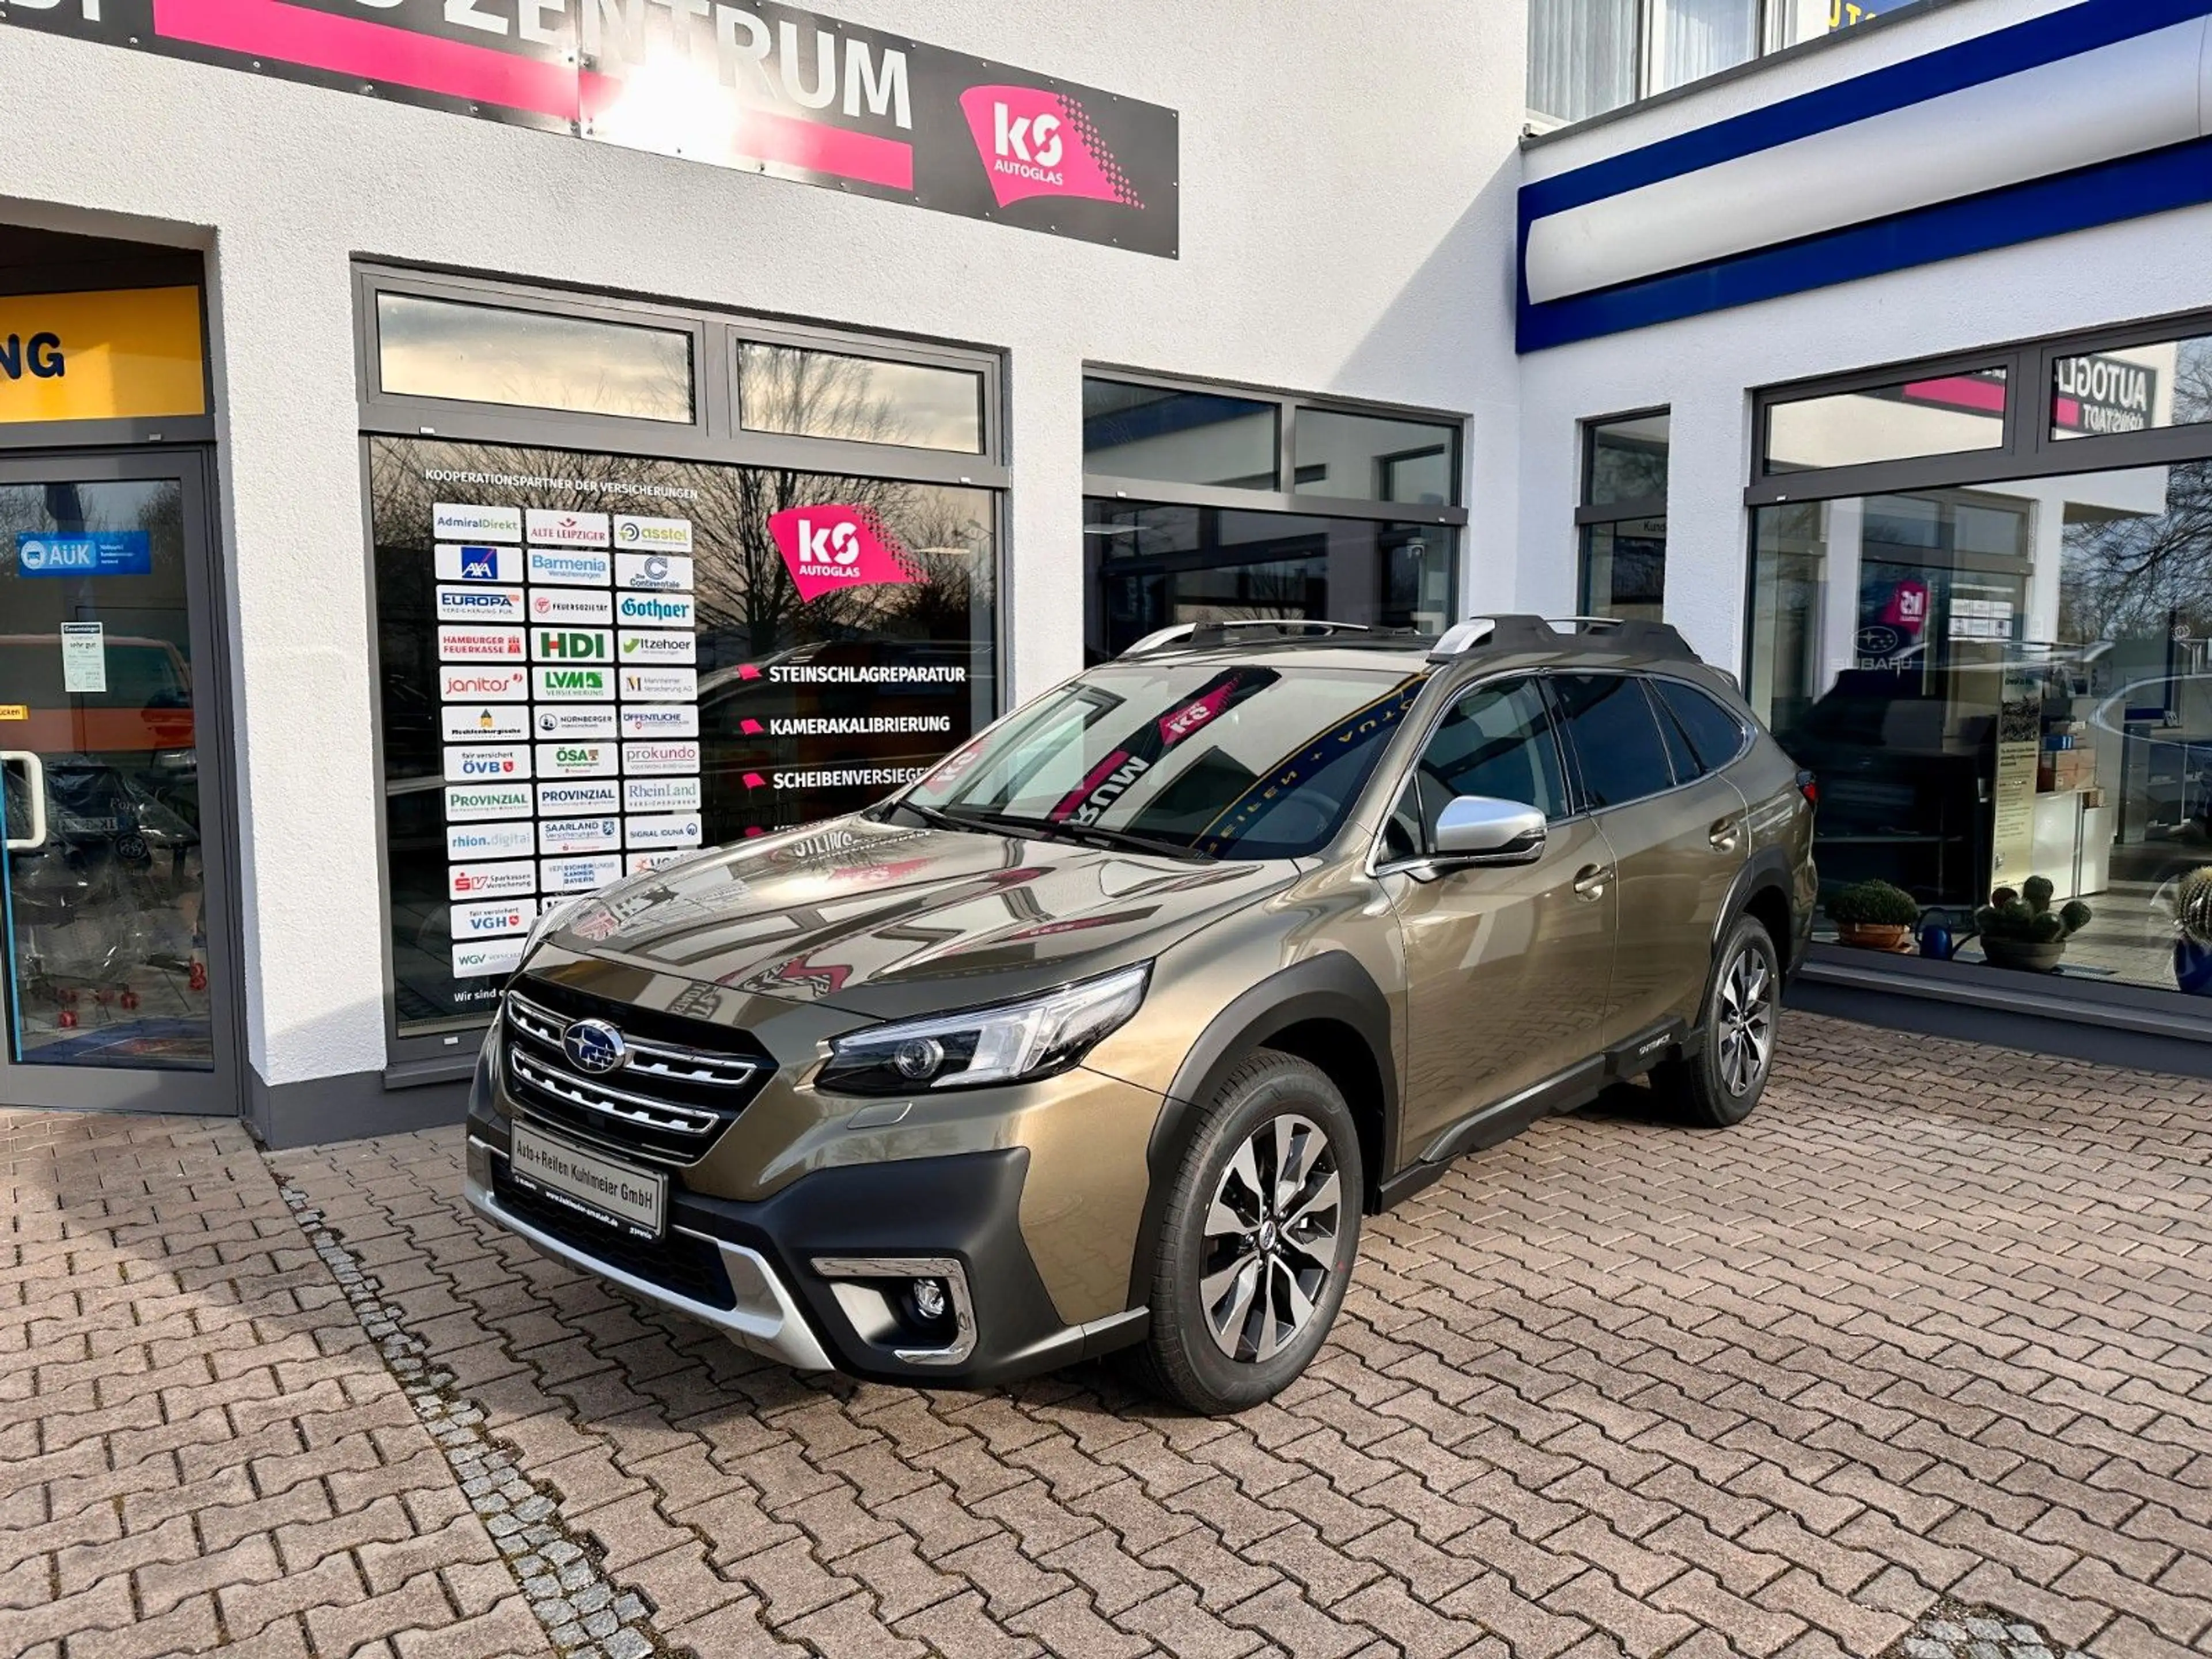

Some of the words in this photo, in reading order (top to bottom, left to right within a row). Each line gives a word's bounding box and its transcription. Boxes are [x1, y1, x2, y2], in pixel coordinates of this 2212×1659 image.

[994, 159, 1063, 185] AUTOGLAS
[425, 469, 571, 490] KOOPERATIONSPARTNER
[575, 479, 597, 493] DER
[600, 482, 698, 499] VERSICHERUNGEN
[437, 517, 518, 531] AdmiralDirekt
[531, 528, 554, 537] ALTE
[557, 529, 605, 541] LEIPZIGER
[642, 527, 688, 541] asstel
[462, 562, 493, 577] AXA
[532, 554, 606, 571] Barmenia
[799, 565, 860, 578] AUTOGLAS
[442, 593, 513, 607] EUROPA
[621, 597, 690, 620] Gothaer
[443, 636, 505, 644] HAMBURGER
[541, 631, 604, 658] HDI
[641, 638, 691, 650] Itzehoer
[545, 671, 584, 688] LVM
[769, 666, 966, 683] STEINSCHLAGREPARATUR
[445, 677, 509, 695] janitos
[770, 716, 951, 736] KAMERAKALIBRIERUNG
[556, 747, 588, 762] ÖSA
[626, 745, 696, 762] prokundo
[463, 760, 500, 774] ÖVB
[542, 789, 616, 801] PROVINZIAL
[629, 783, 696, 798] RheinLand
[450, 794, 528, 806] PROVINZIAL
[545, 822, 599, 832] SAARLAND
[452, 833, 531, 848] rhion.digital
[471, 916, 507, 930] VGH
[454, 992, 472, 1002] Wir
[474, 988, 497, 1000] sind
[570, 1162, 619, 1199] Kuhlmeier
[620, 1182, 653, 1210] GmbH
